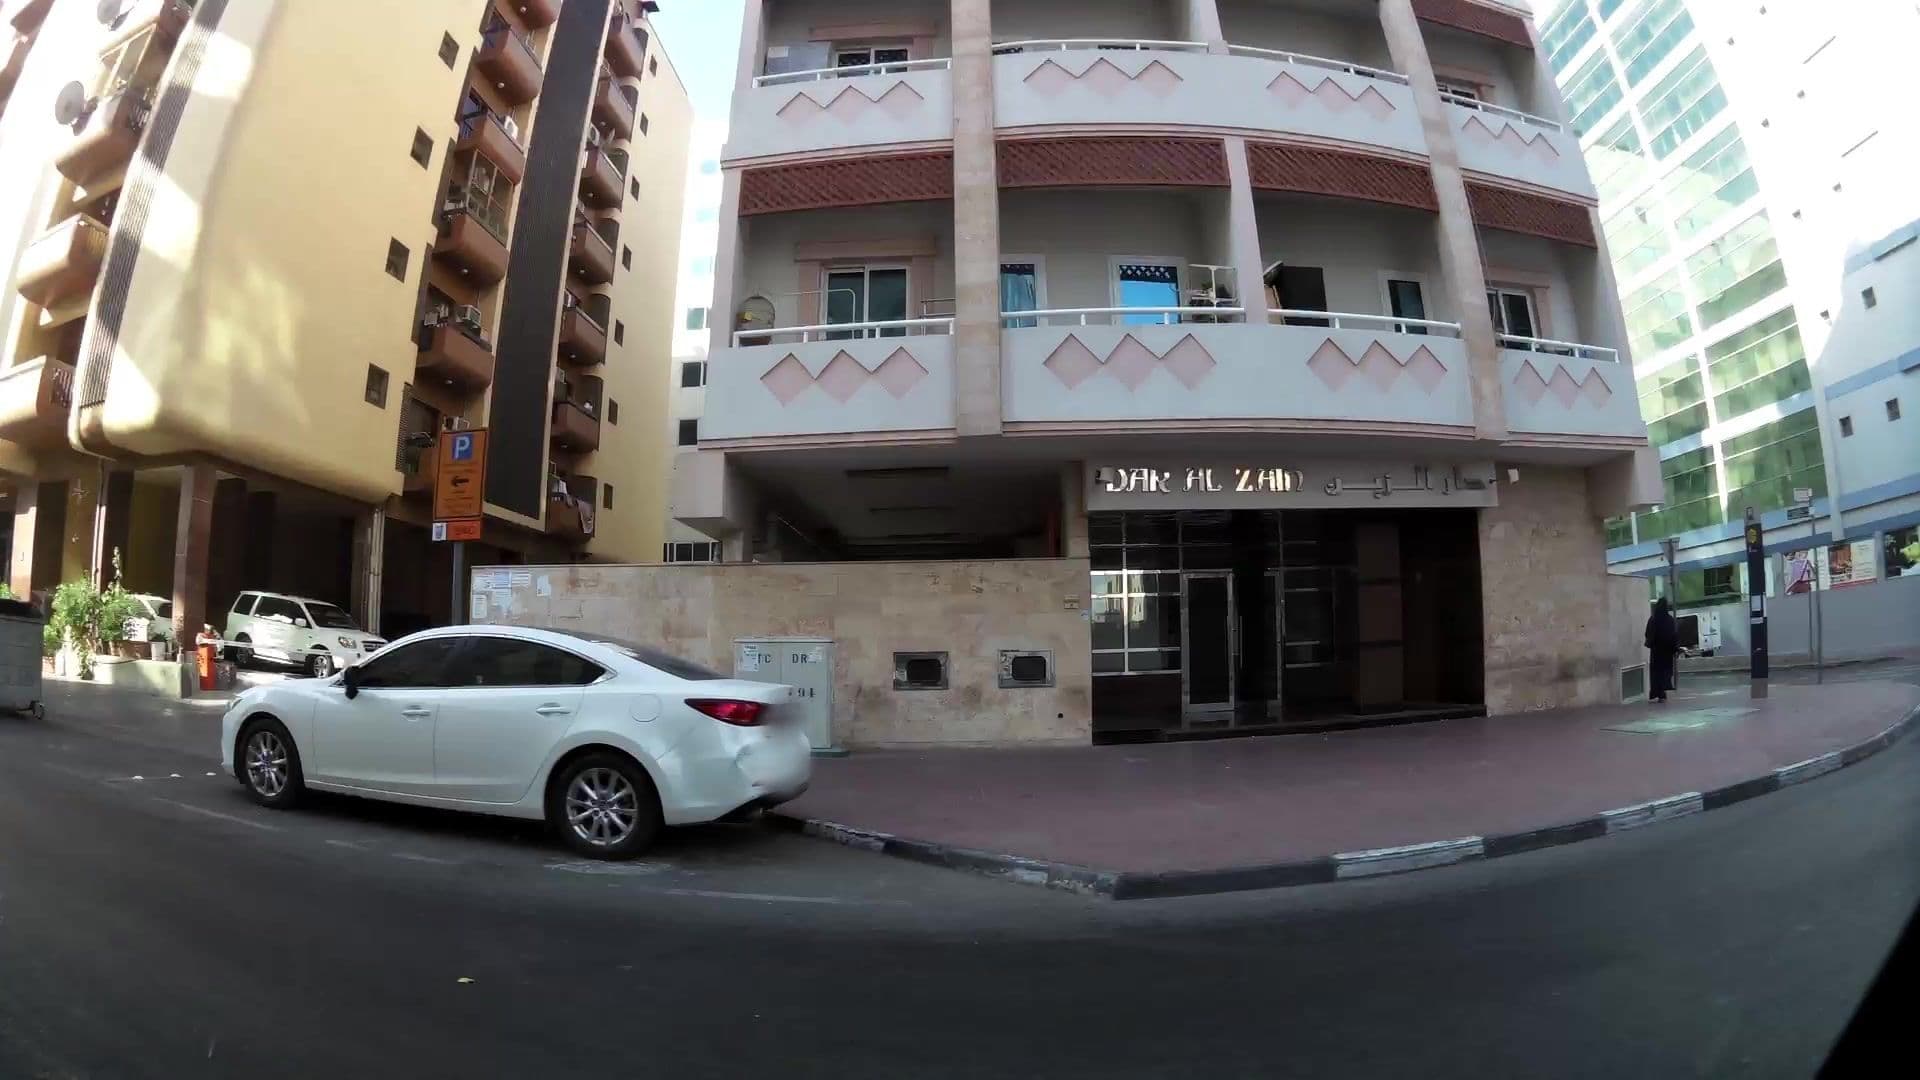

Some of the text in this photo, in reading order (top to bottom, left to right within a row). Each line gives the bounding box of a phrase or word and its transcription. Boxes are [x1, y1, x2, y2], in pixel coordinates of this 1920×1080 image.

[454, 436, 471, 460] P
[1104, 467, 1305, 493] DAR AL ZAIN
[1440, 464, 1486, 496] دار
